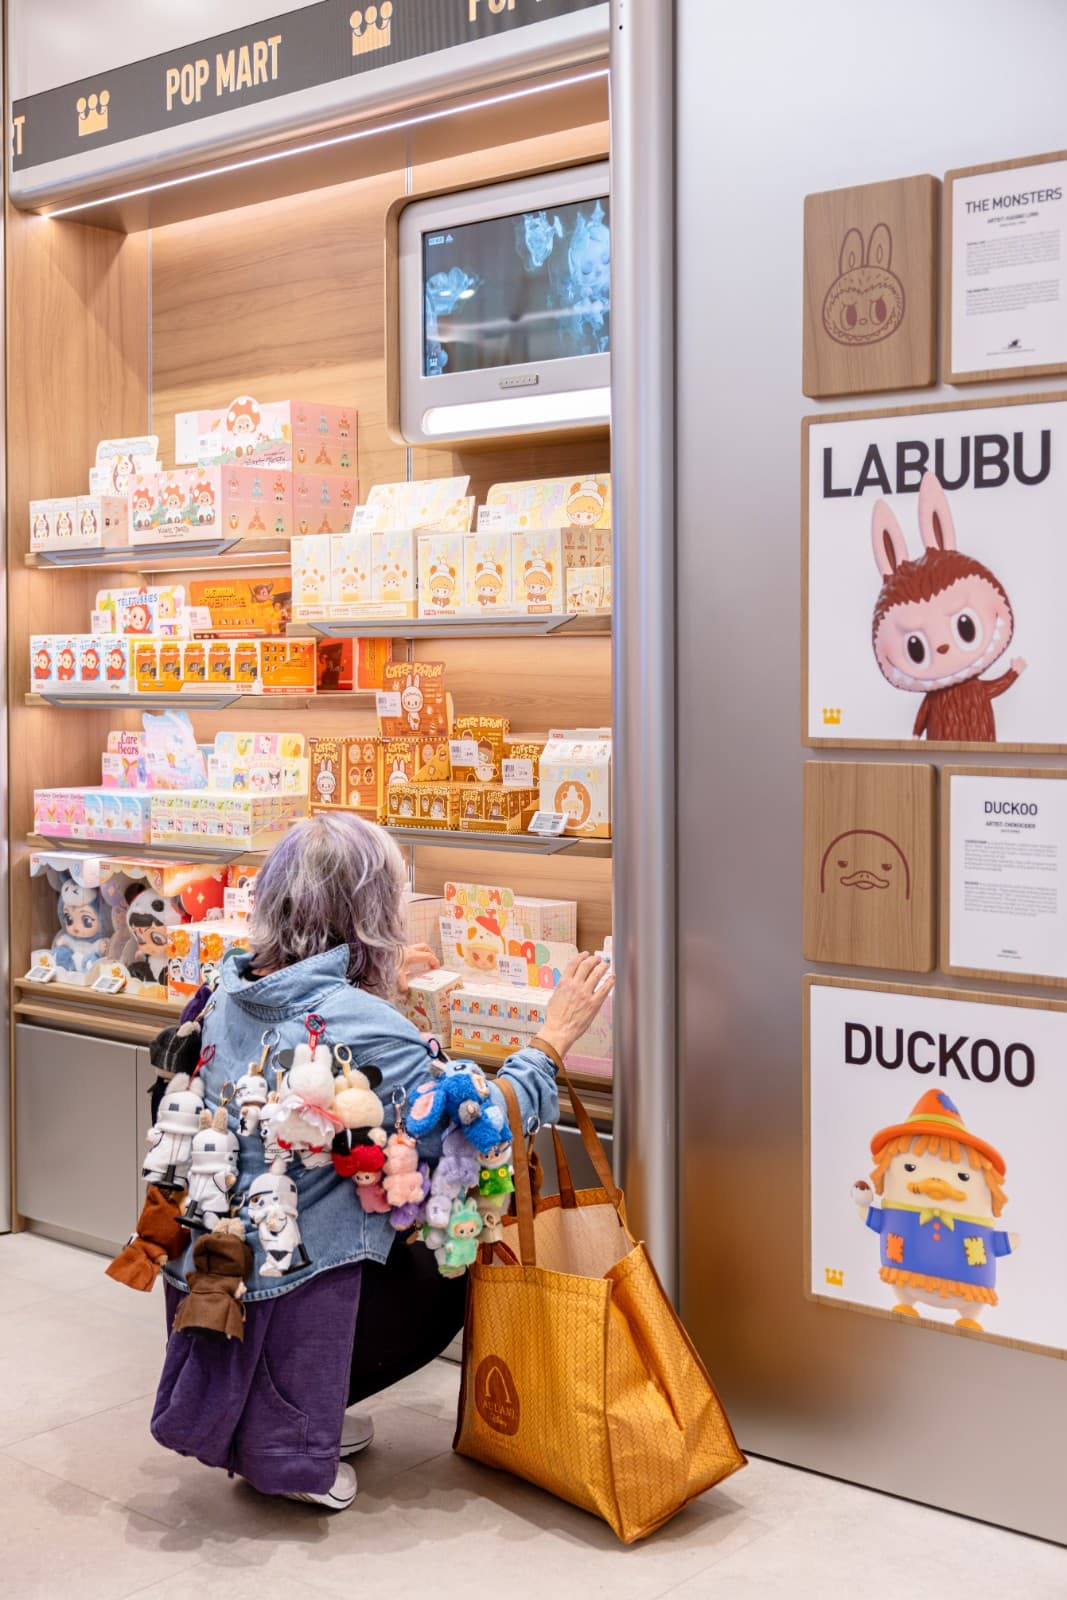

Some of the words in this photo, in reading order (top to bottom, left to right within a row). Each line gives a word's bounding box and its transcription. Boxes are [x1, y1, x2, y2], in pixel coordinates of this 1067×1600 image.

[166, 58, 210, 111] POP
[215, 34, 282, 97] MART
[965, 198, 990, 214] THE
[992, 187, 1063, 210] MONSTERS
[823, 429, 1051, 498] LABUBU
[118, 742, 139, 755] Bears
[121, 731, 138, 744] Care
[984, 800, 1038, 816] DUCKOO
[844, 1021, 1036, 1088] DUCKOO
